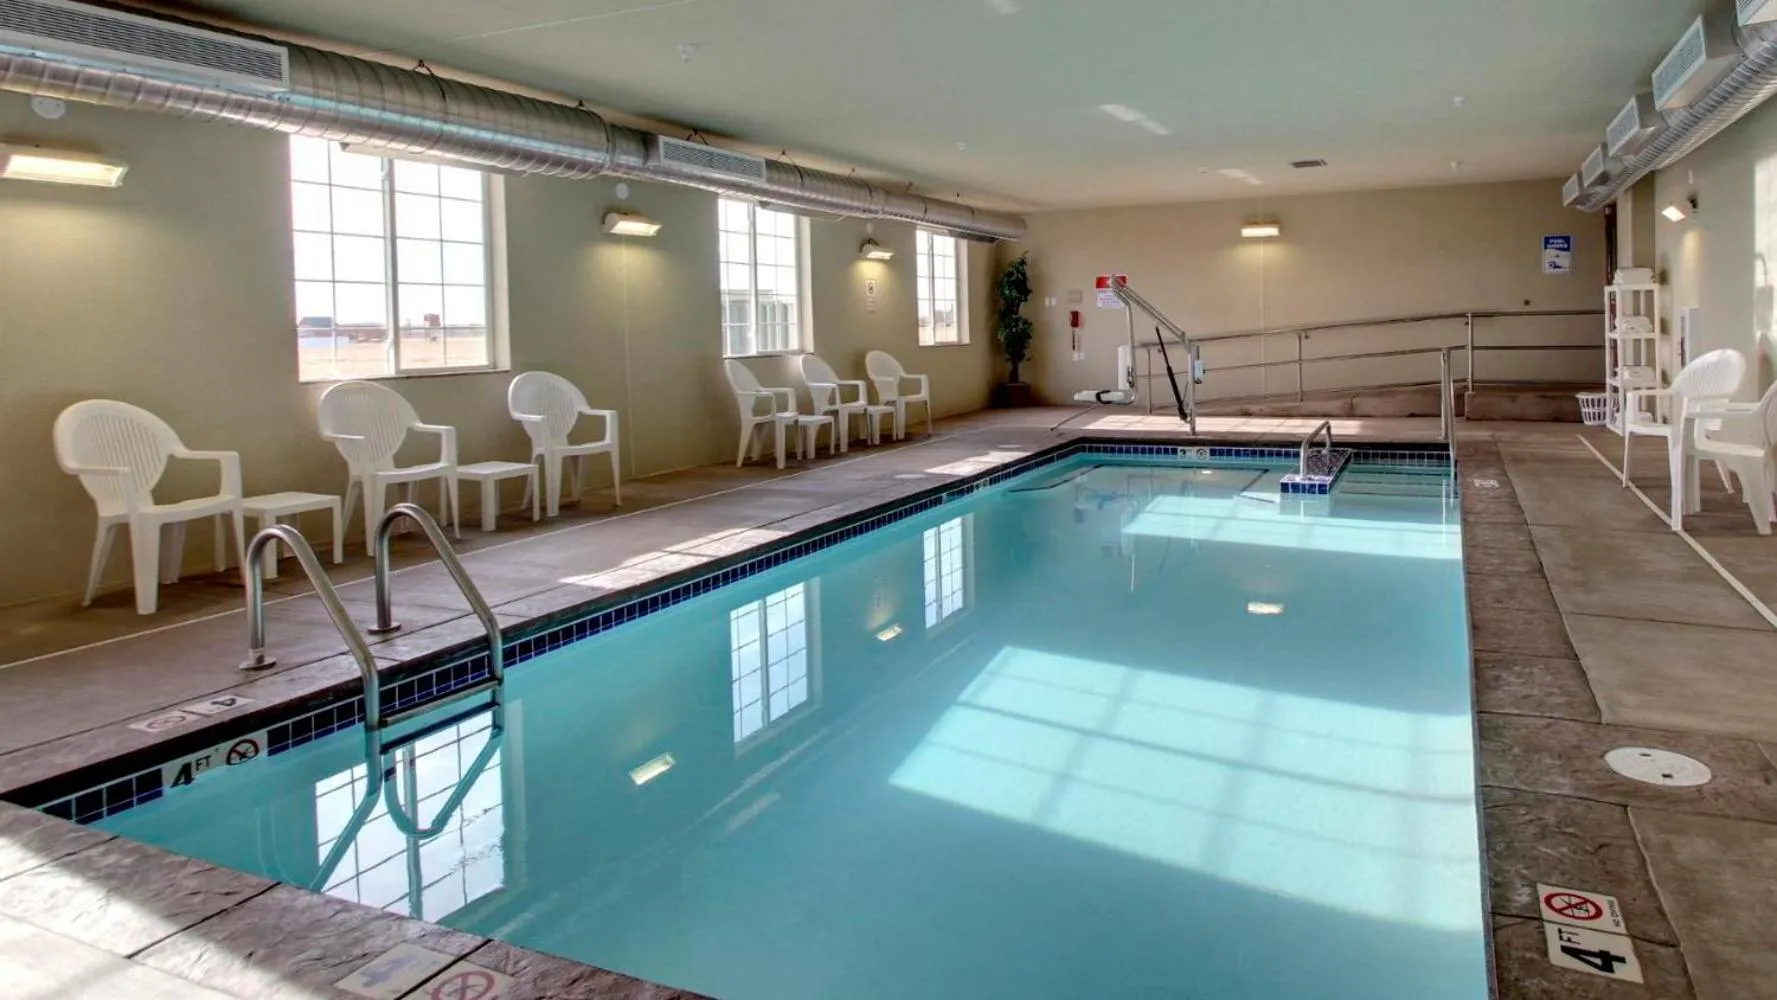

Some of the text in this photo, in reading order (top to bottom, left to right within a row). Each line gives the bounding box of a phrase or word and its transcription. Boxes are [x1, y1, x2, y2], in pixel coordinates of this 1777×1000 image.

[171, 755, 212, 788] 4 FT
[1558, 928, 1626, 973] 4 FT
